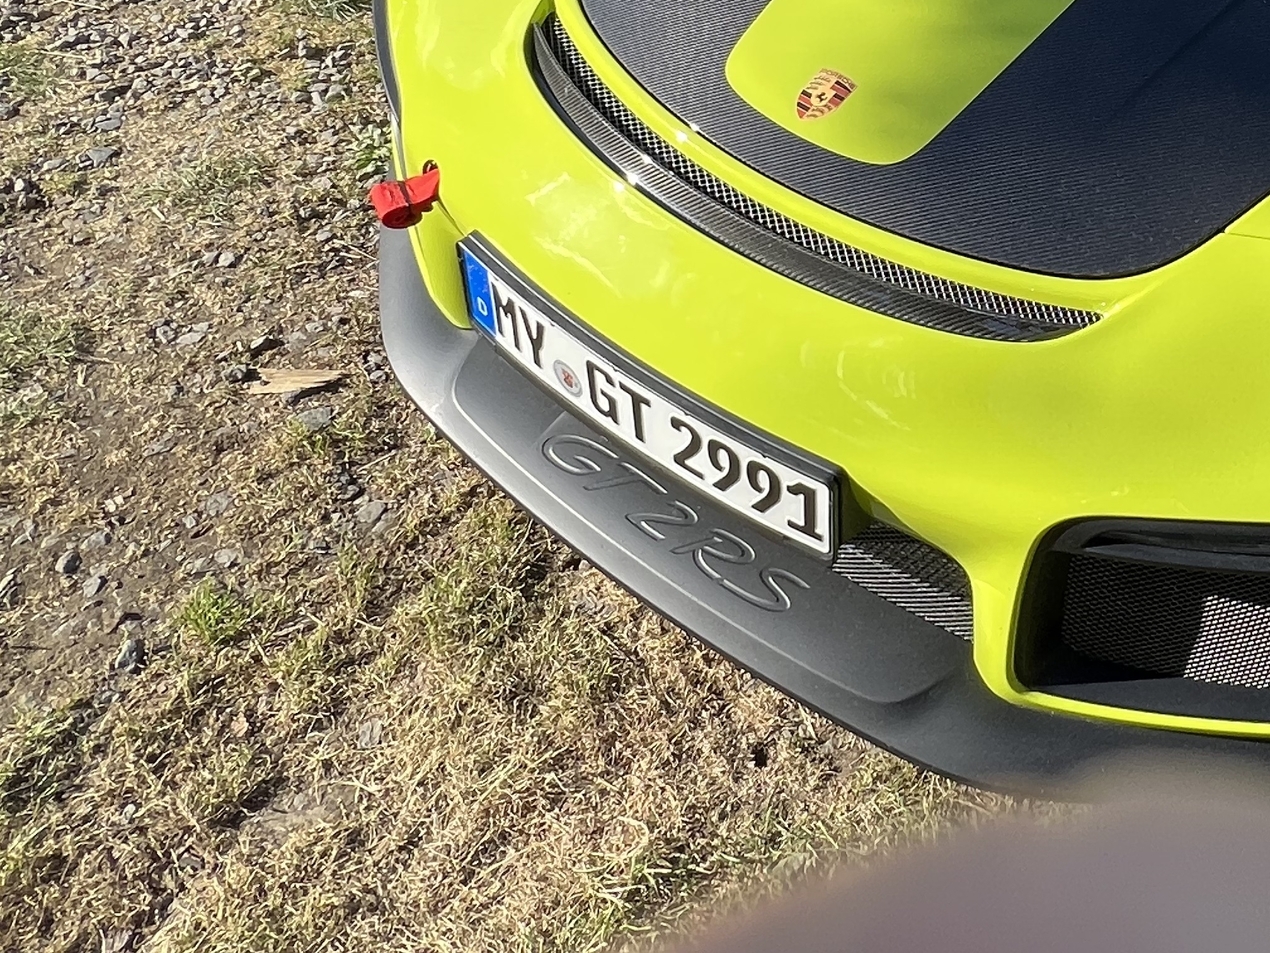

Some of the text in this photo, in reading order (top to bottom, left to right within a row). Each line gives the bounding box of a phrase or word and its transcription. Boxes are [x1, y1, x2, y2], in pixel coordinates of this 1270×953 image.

[477, 295, 489, 317] D
[493, 281, 824, 541] MY GT 2991
